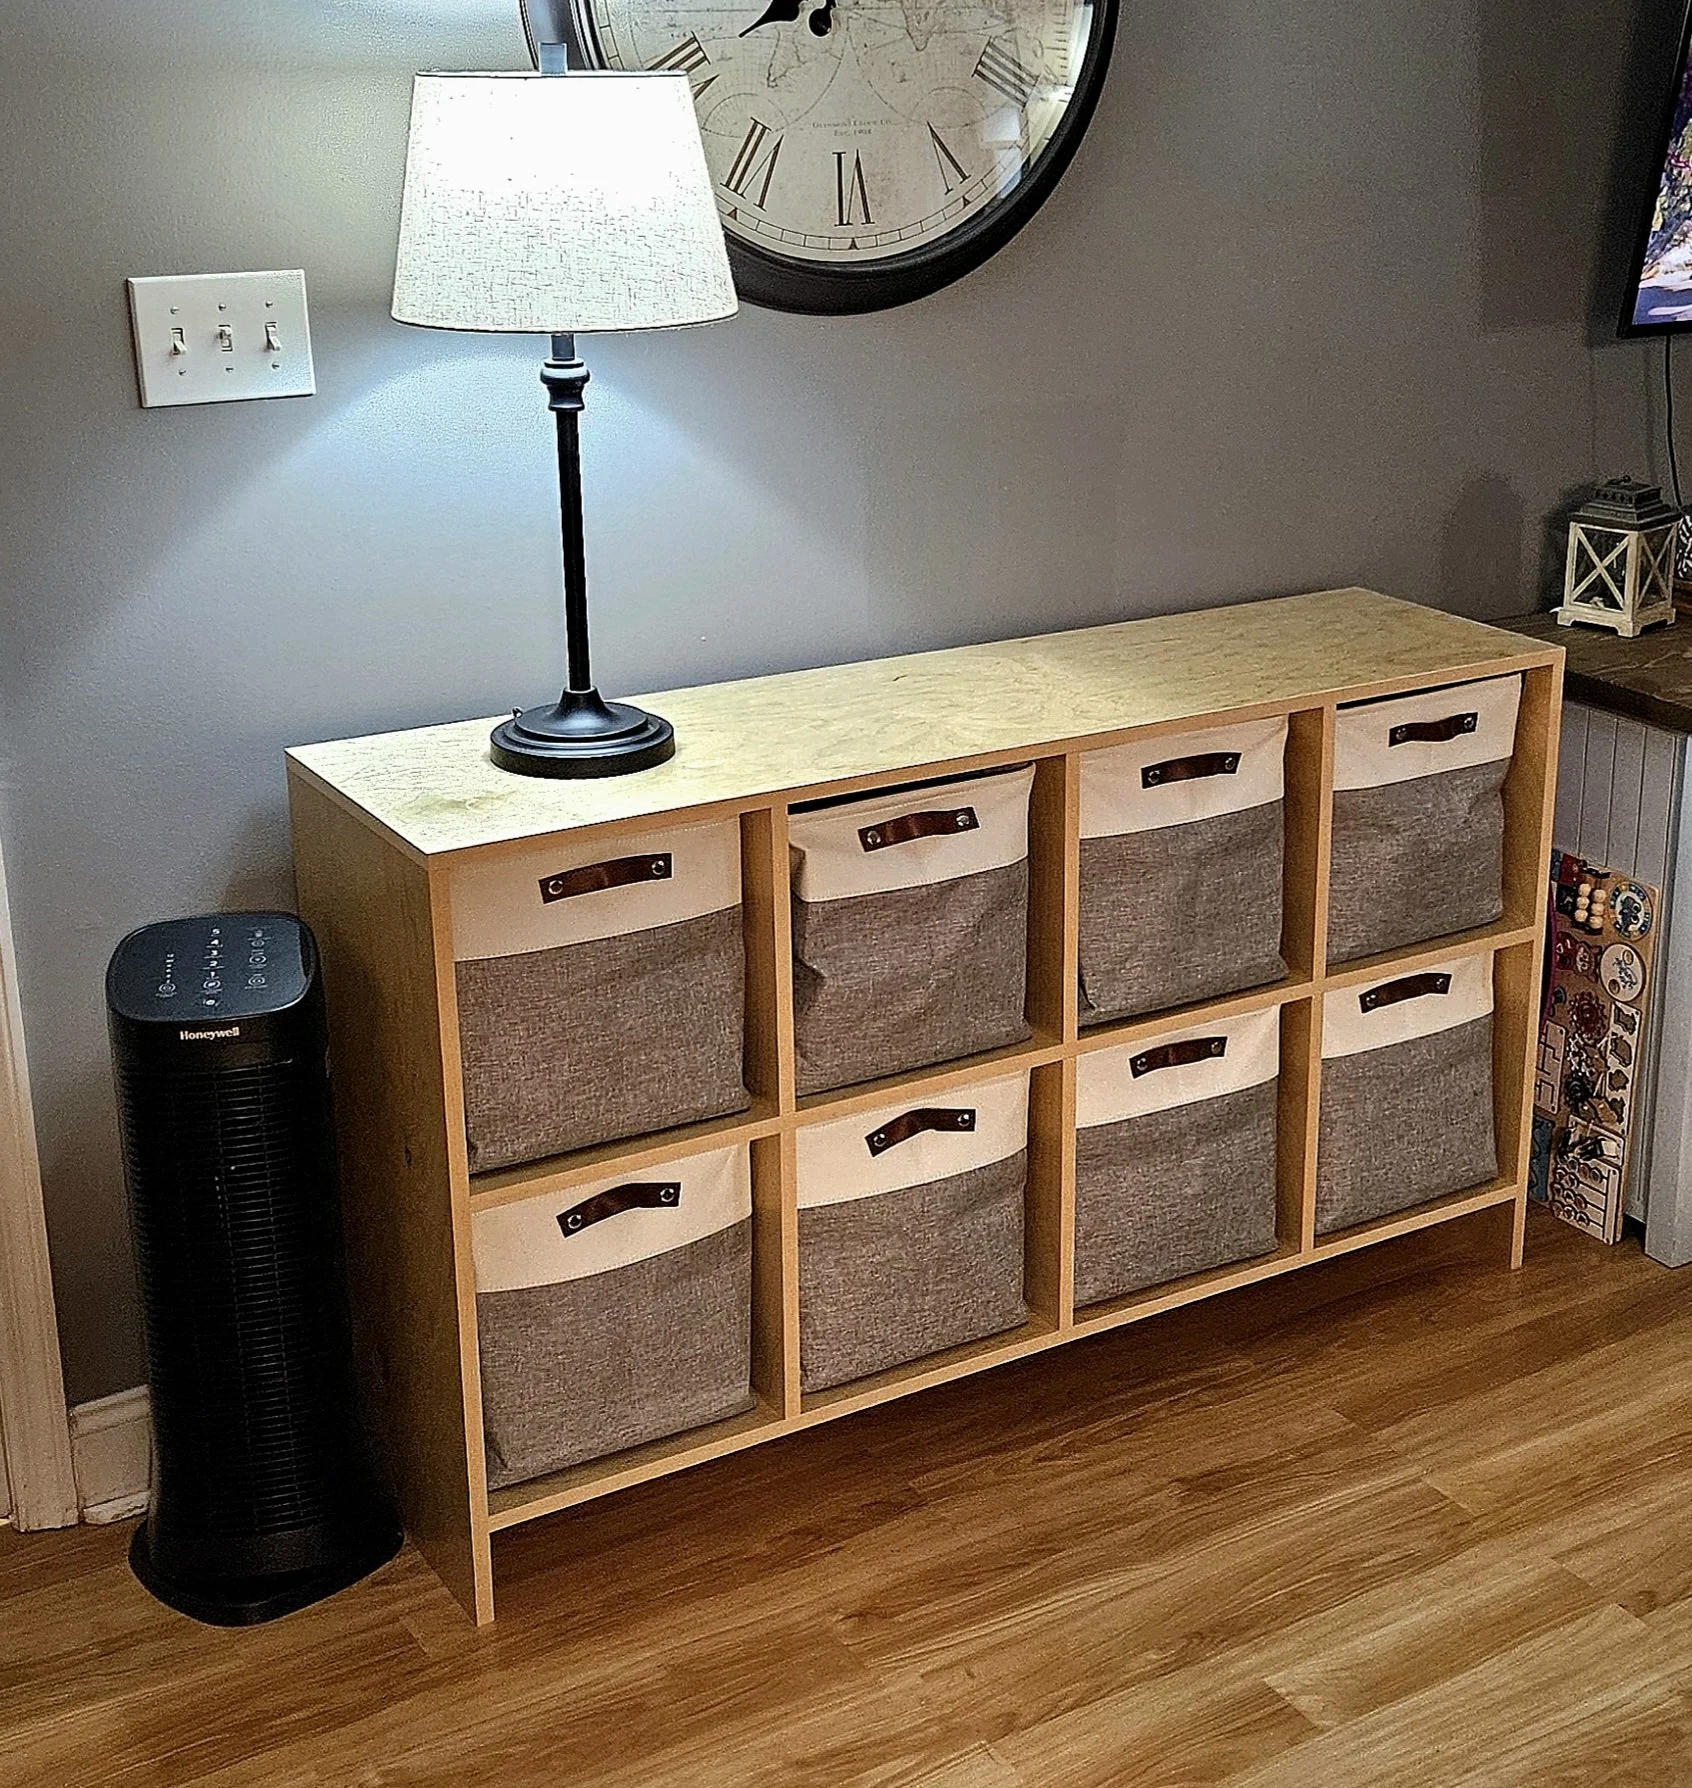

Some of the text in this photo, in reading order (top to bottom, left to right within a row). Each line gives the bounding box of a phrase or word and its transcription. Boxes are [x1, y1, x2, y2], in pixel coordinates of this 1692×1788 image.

[719, 116, 784, 212] VII
[832, 149, 876, 227] VI
[926, 120, 971, 196] V
[180, 1026, 240, 1041] Honeywell
